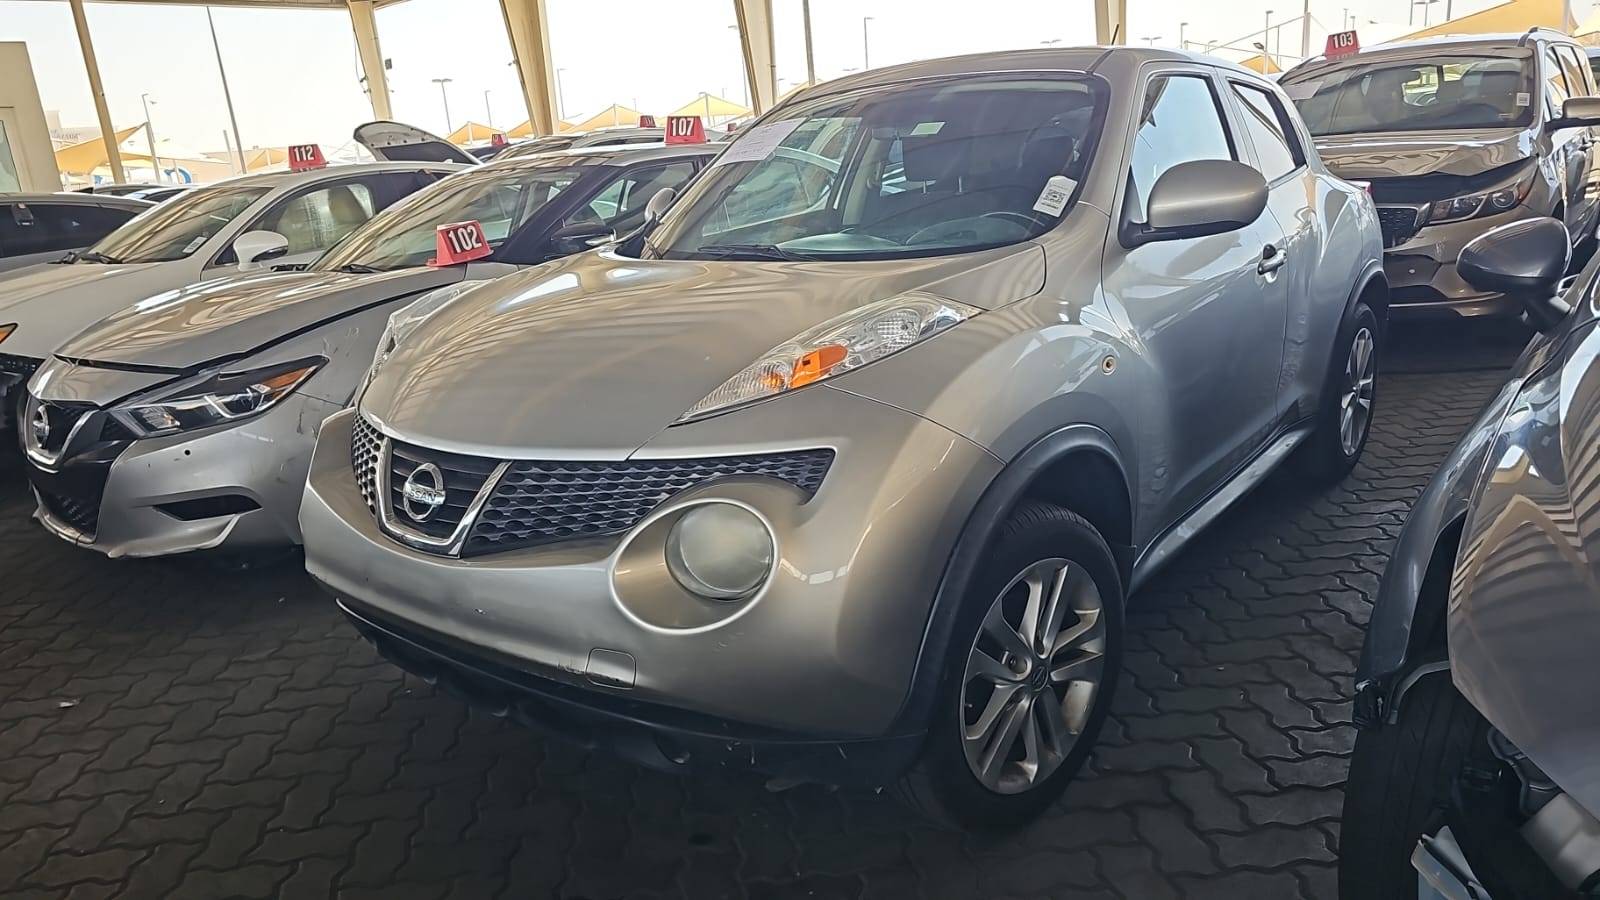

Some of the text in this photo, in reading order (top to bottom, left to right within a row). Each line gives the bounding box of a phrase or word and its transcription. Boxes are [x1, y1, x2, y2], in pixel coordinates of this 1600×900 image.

[1333, 32, 1354, 49] 103
[671, 117, 695, 137] 107
[294, 145, 315, 162] 112
[448, 225, 482, 253] 102
[405, 486, 437, 502] SSAN
